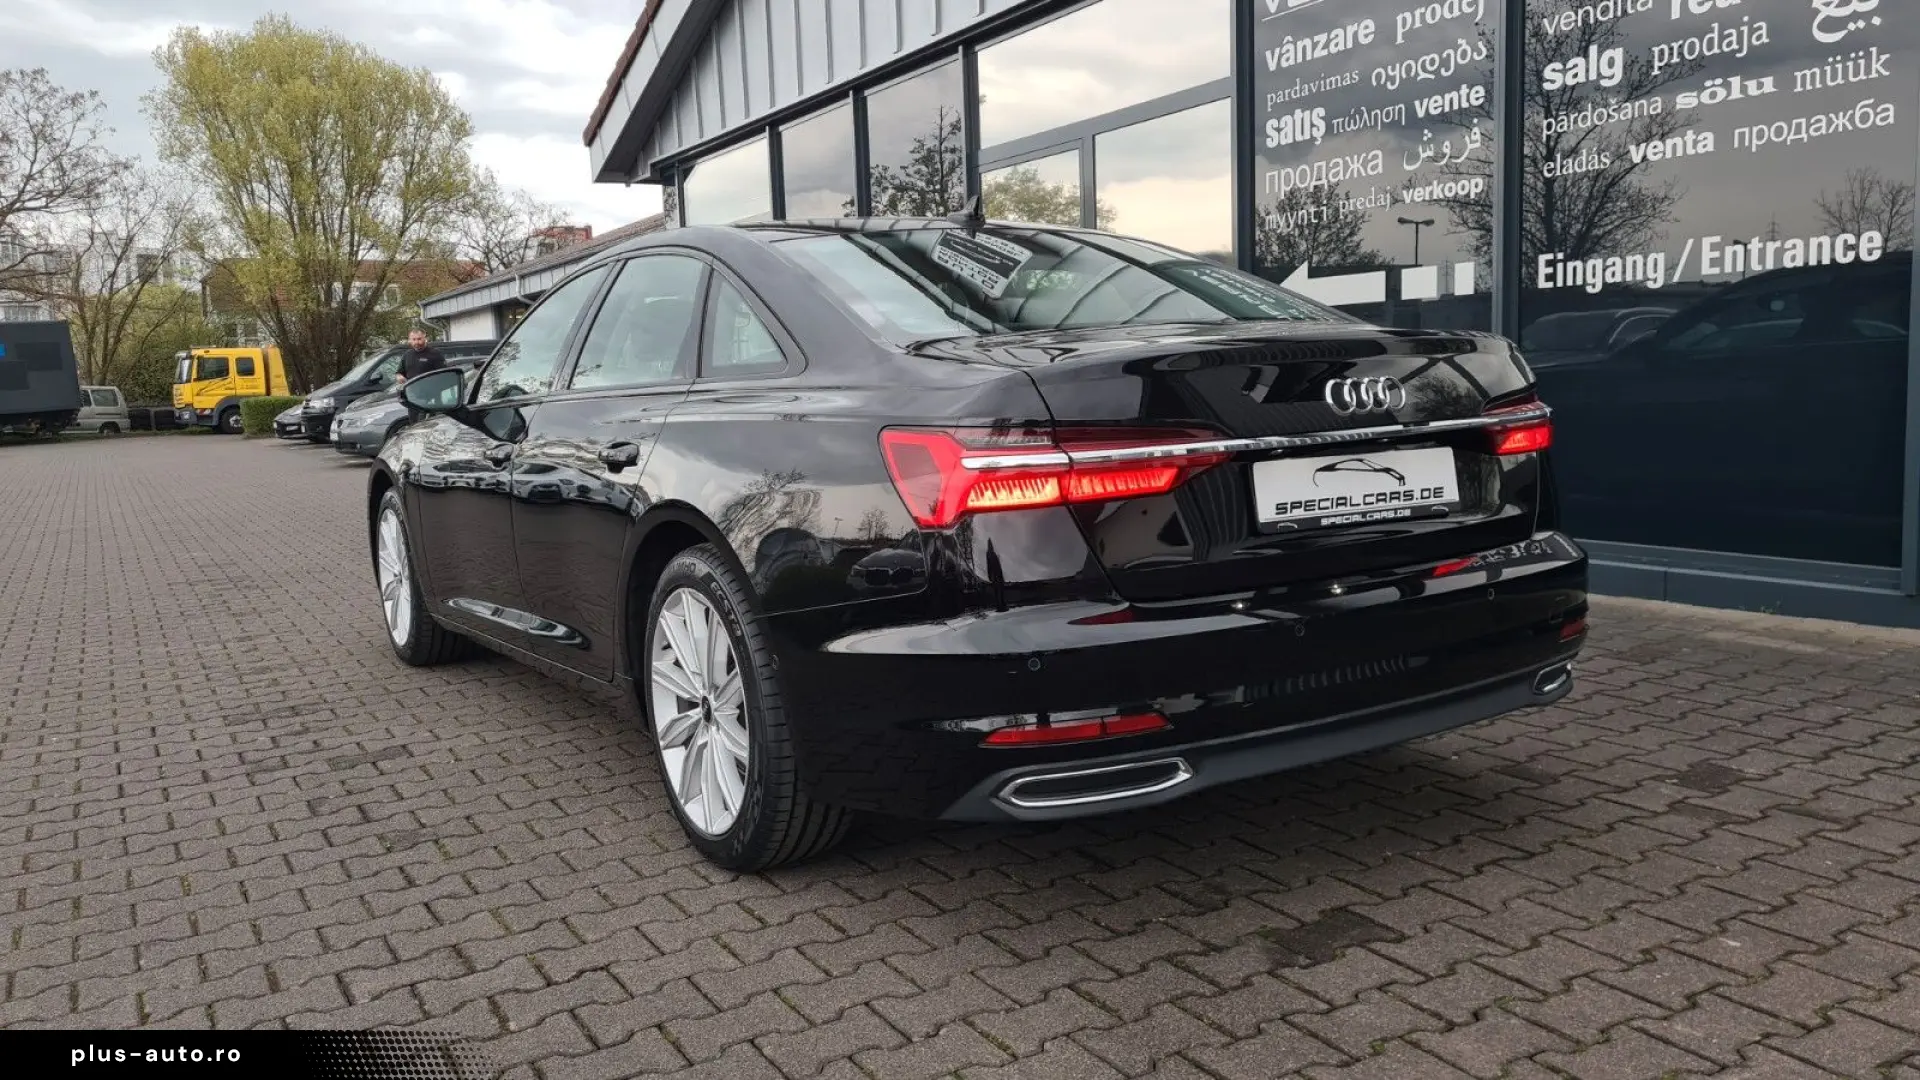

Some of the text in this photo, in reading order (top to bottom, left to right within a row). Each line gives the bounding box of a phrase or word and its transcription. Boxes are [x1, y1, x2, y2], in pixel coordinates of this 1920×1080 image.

[1265, 18, 1375, 71] vânzare
[1542, 16, 1770, 90] salg prodaja
[1266, 84, 1485, 149] satış πώληση vente
[1267, 70, 1360, 112] pardavimas
[1542, 47, 1891, 140] pārdošana sölu müük
[1266, 118, 1481, 200] продажа فروش
[1542, 98, 1895, 178] eladás venta продажба
[1265, 178, 1484, 233] myynti predaj verkoop
[1537, 230, 1883, 294] Eingang / Entrance
[1275, 487, 1444, 515] SPECIALCARS.DE
[1321, 509, 1411, 526] SPECIALCARS.DE
